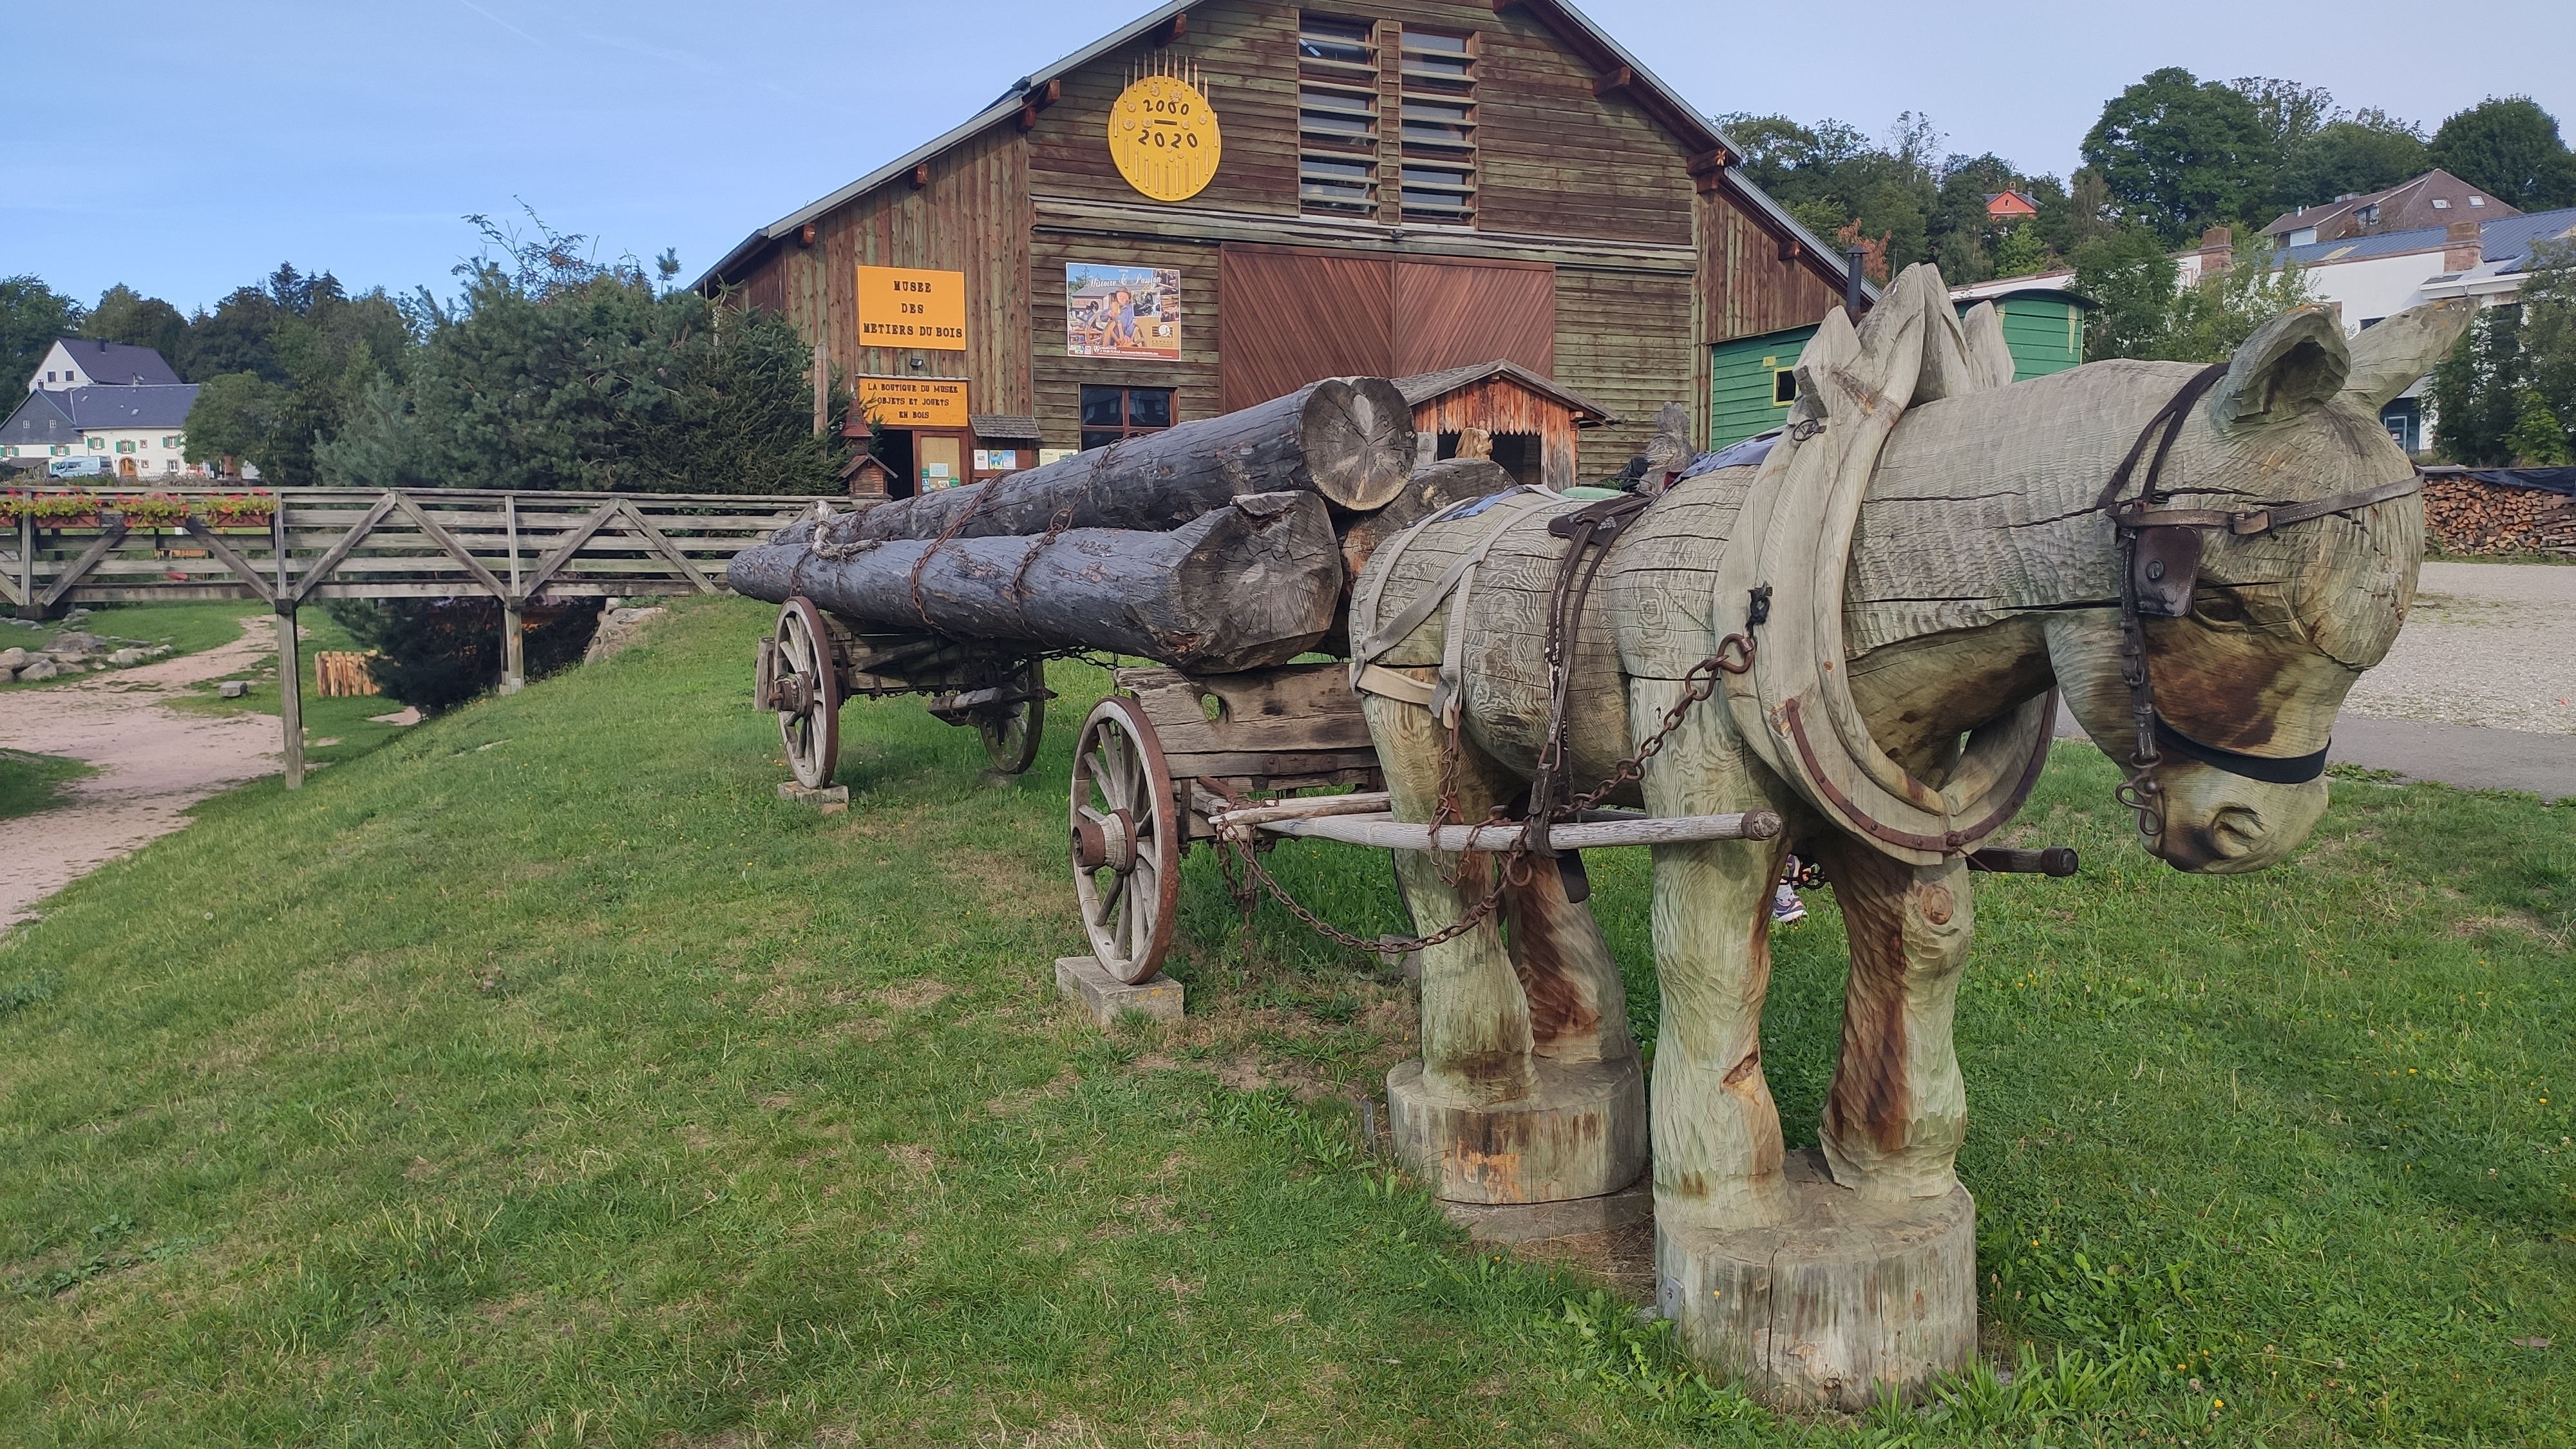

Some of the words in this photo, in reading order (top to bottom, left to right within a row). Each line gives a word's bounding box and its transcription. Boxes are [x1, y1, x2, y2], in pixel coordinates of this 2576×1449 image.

[1143, 99, 1189, 115] 2000
[1137, 129, 1198, 149] 2020
[893, 280, 932, 293] MUSEE
[1089, 276, 1117, 289] Histoire
[1119, 273, 1128, 285] &
[1133, 273, 1162, 285] Passion
[900, 303, 924, 314] DES
[863, 322, 914, 336] METIERS
[919, 325, 933, 336] DU
[936, 327, 963, 338] BOIS
[867, 383, 878, 391] LA
[881, 383, 917, 392] BOUTIQUE
[920, 384, 931, 393] DU
[933, 385, 959, 393] MUSEE
[877, 397, 905, 405] OBJETS
[922, 398, 949, 406] JOUETS
